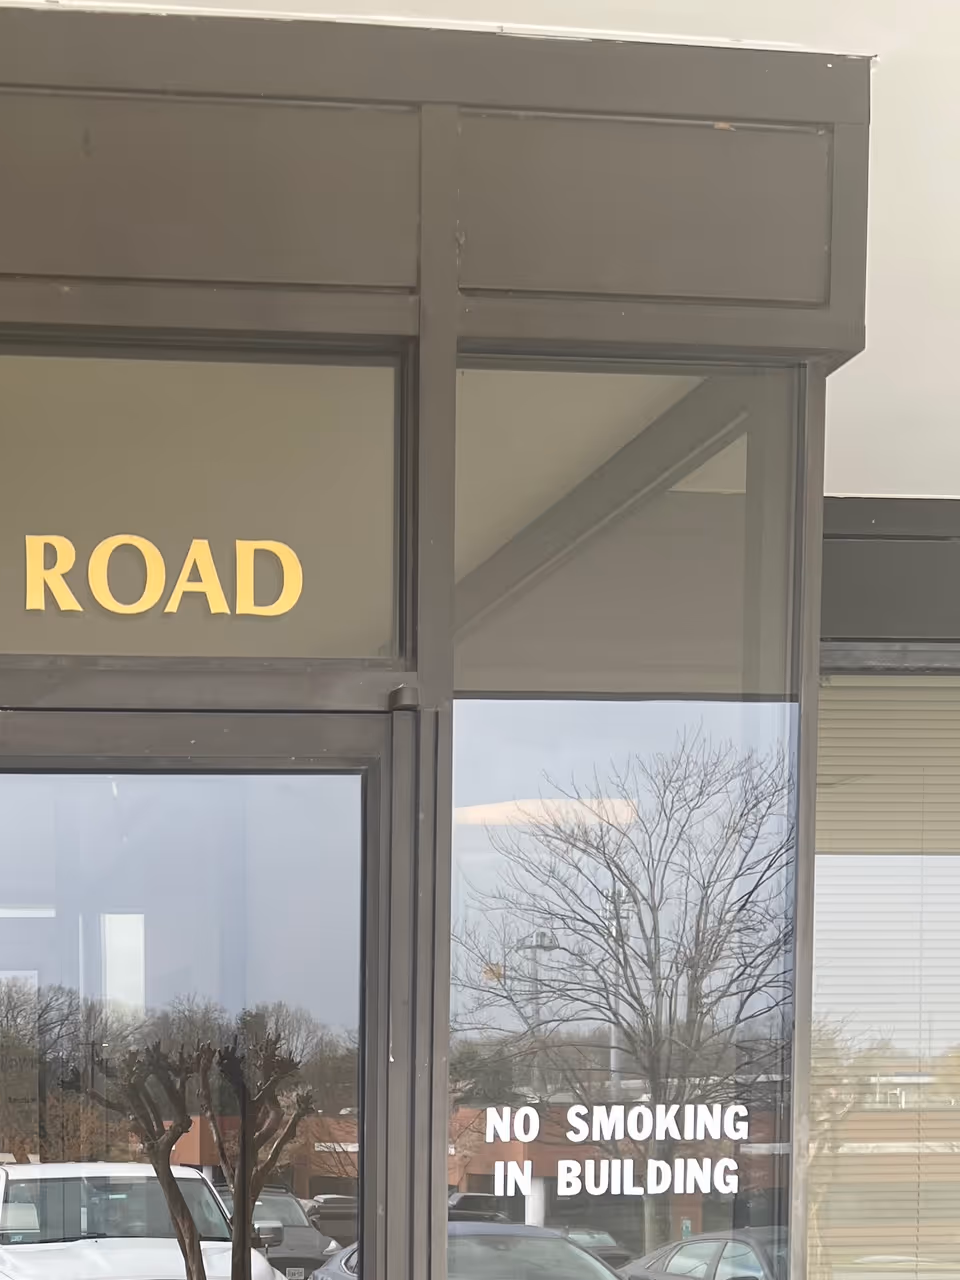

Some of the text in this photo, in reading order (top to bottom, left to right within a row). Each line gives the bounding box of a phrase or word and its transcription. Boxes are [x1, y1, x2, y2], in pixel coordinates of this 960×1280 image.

[25, 533, 303, 616] ROAD
[485, 1104, 749, 1143] NO SMOKING
[493, 1158, 739, 1197] IN BUILDING
